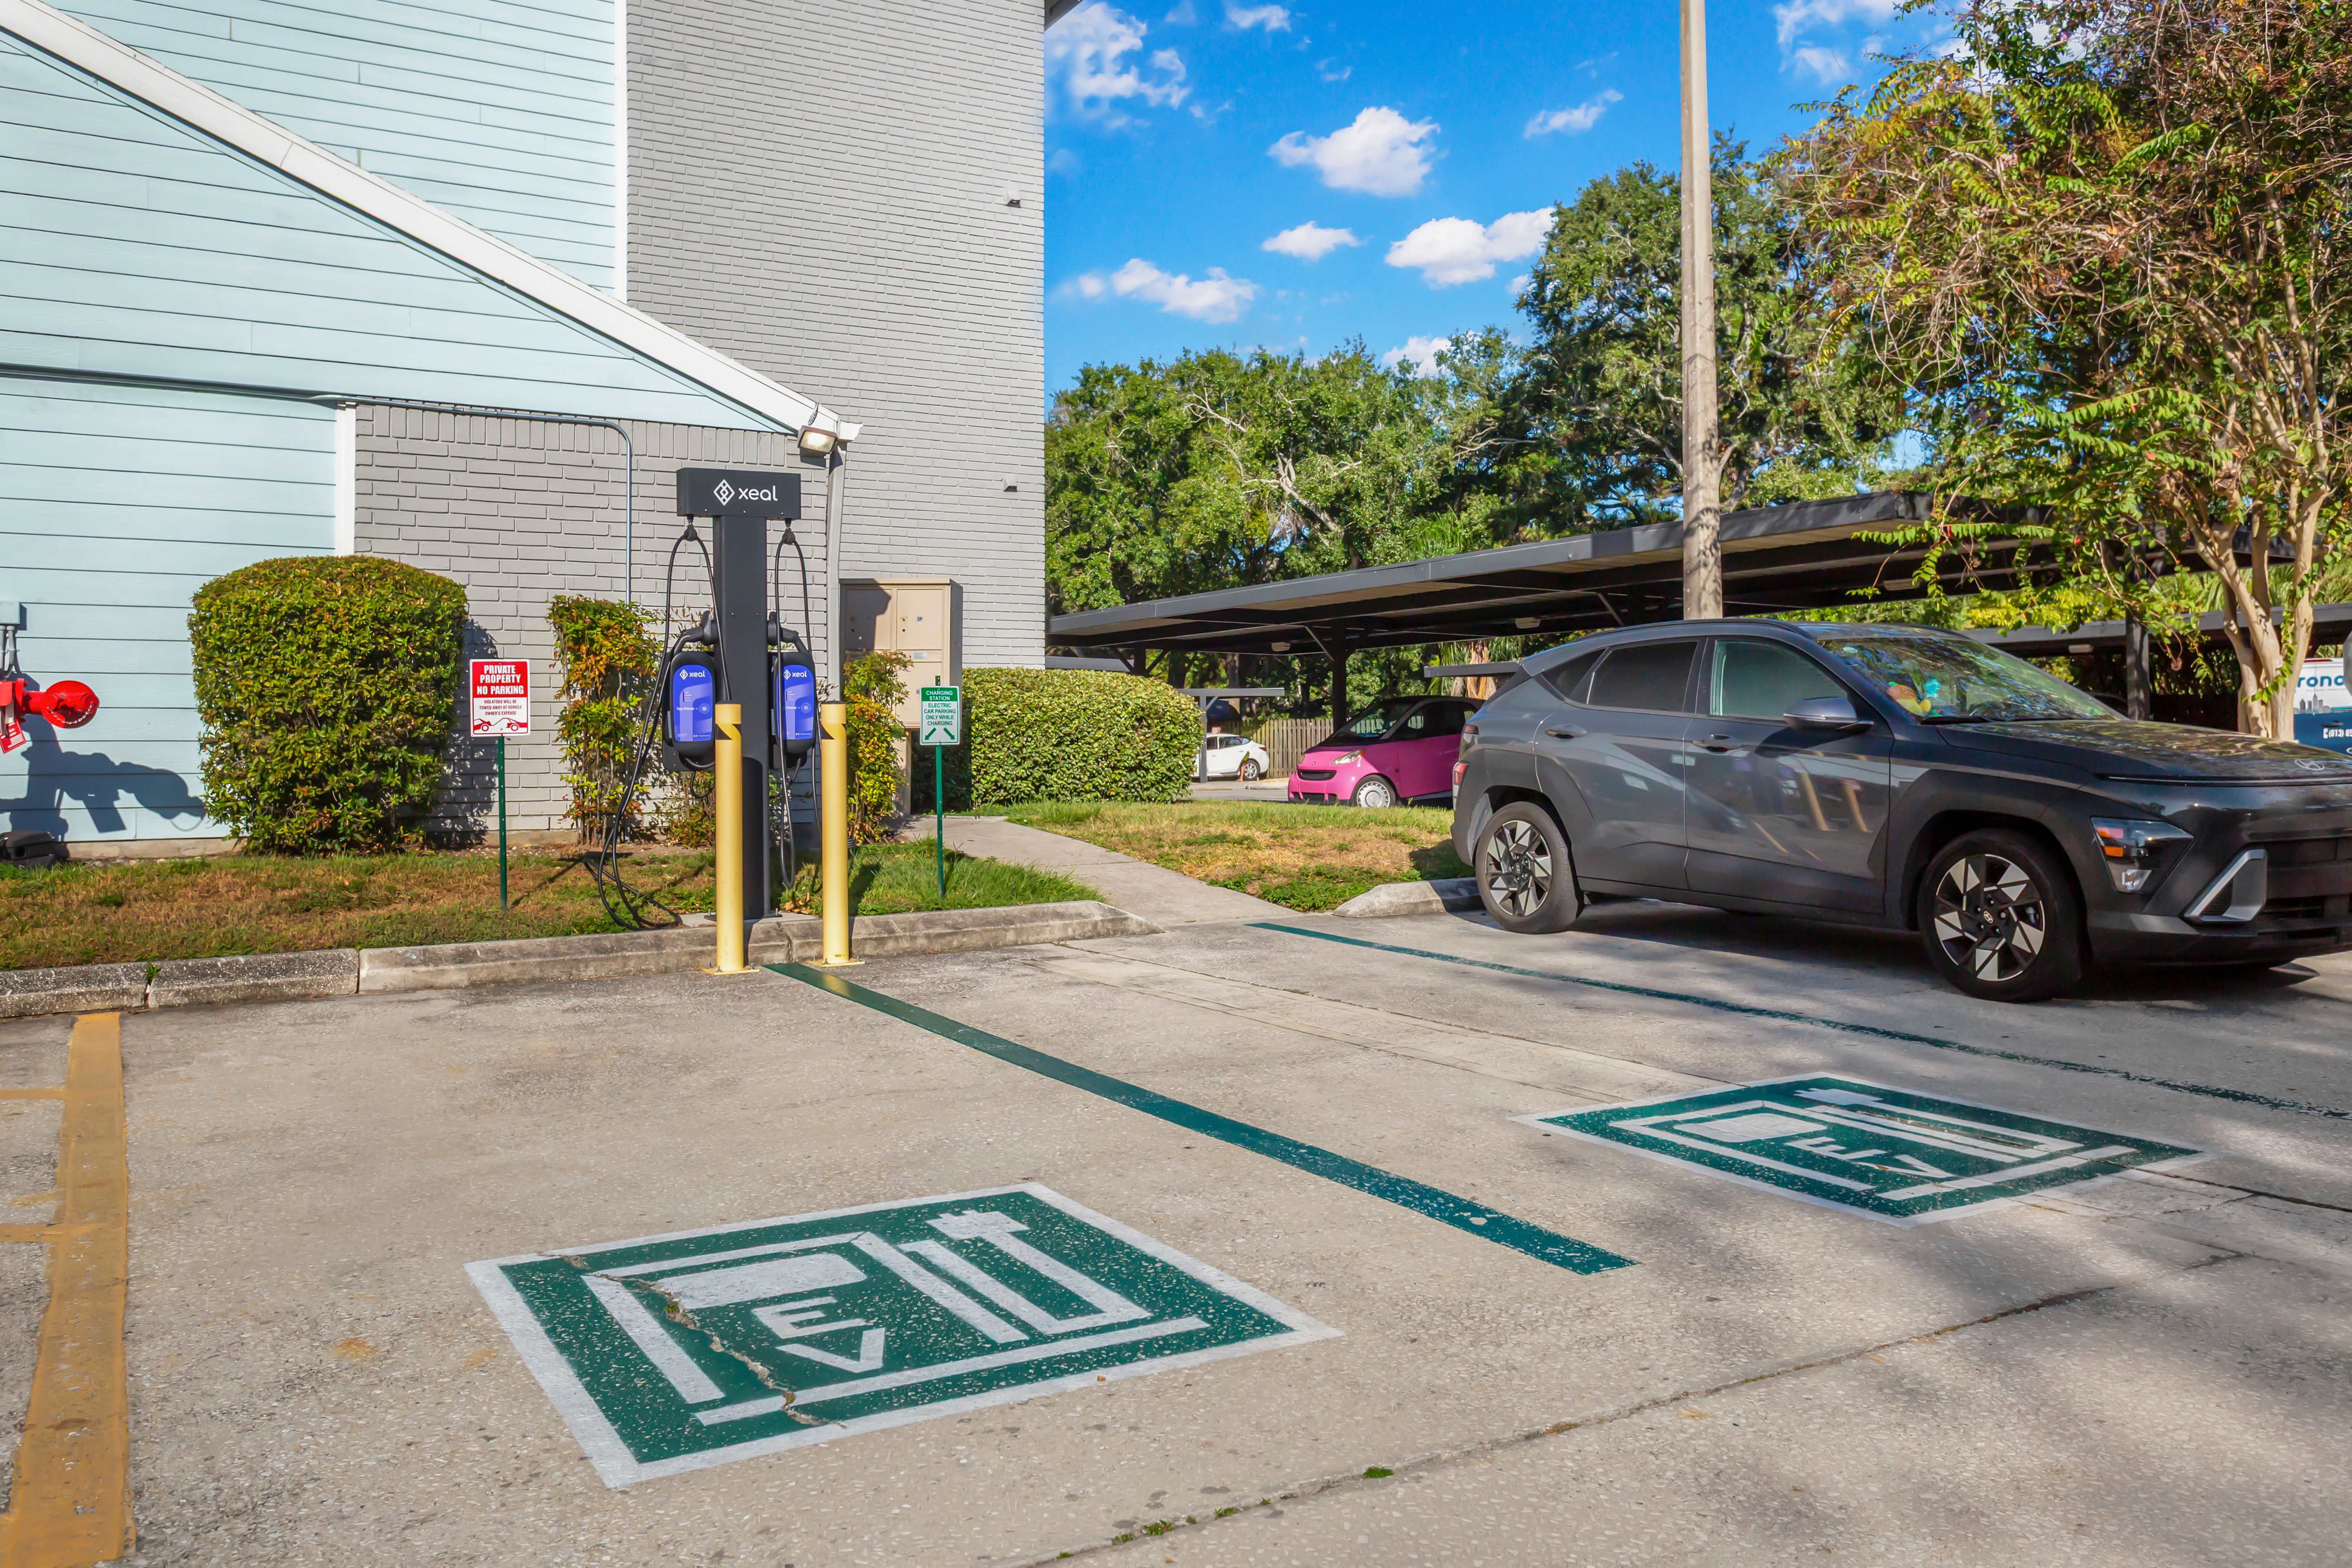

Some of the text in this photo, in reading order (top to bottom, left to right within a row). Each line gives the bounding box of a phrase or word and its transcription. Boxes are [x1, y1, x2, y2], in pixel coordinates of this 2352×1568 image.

[738, 486, 778, 501] xeal
[484, 665, 516, 674] PRIVATE
[480, 674, 521, 683] PROPERTY
[477, 685, 524, 695] NO PARKING
